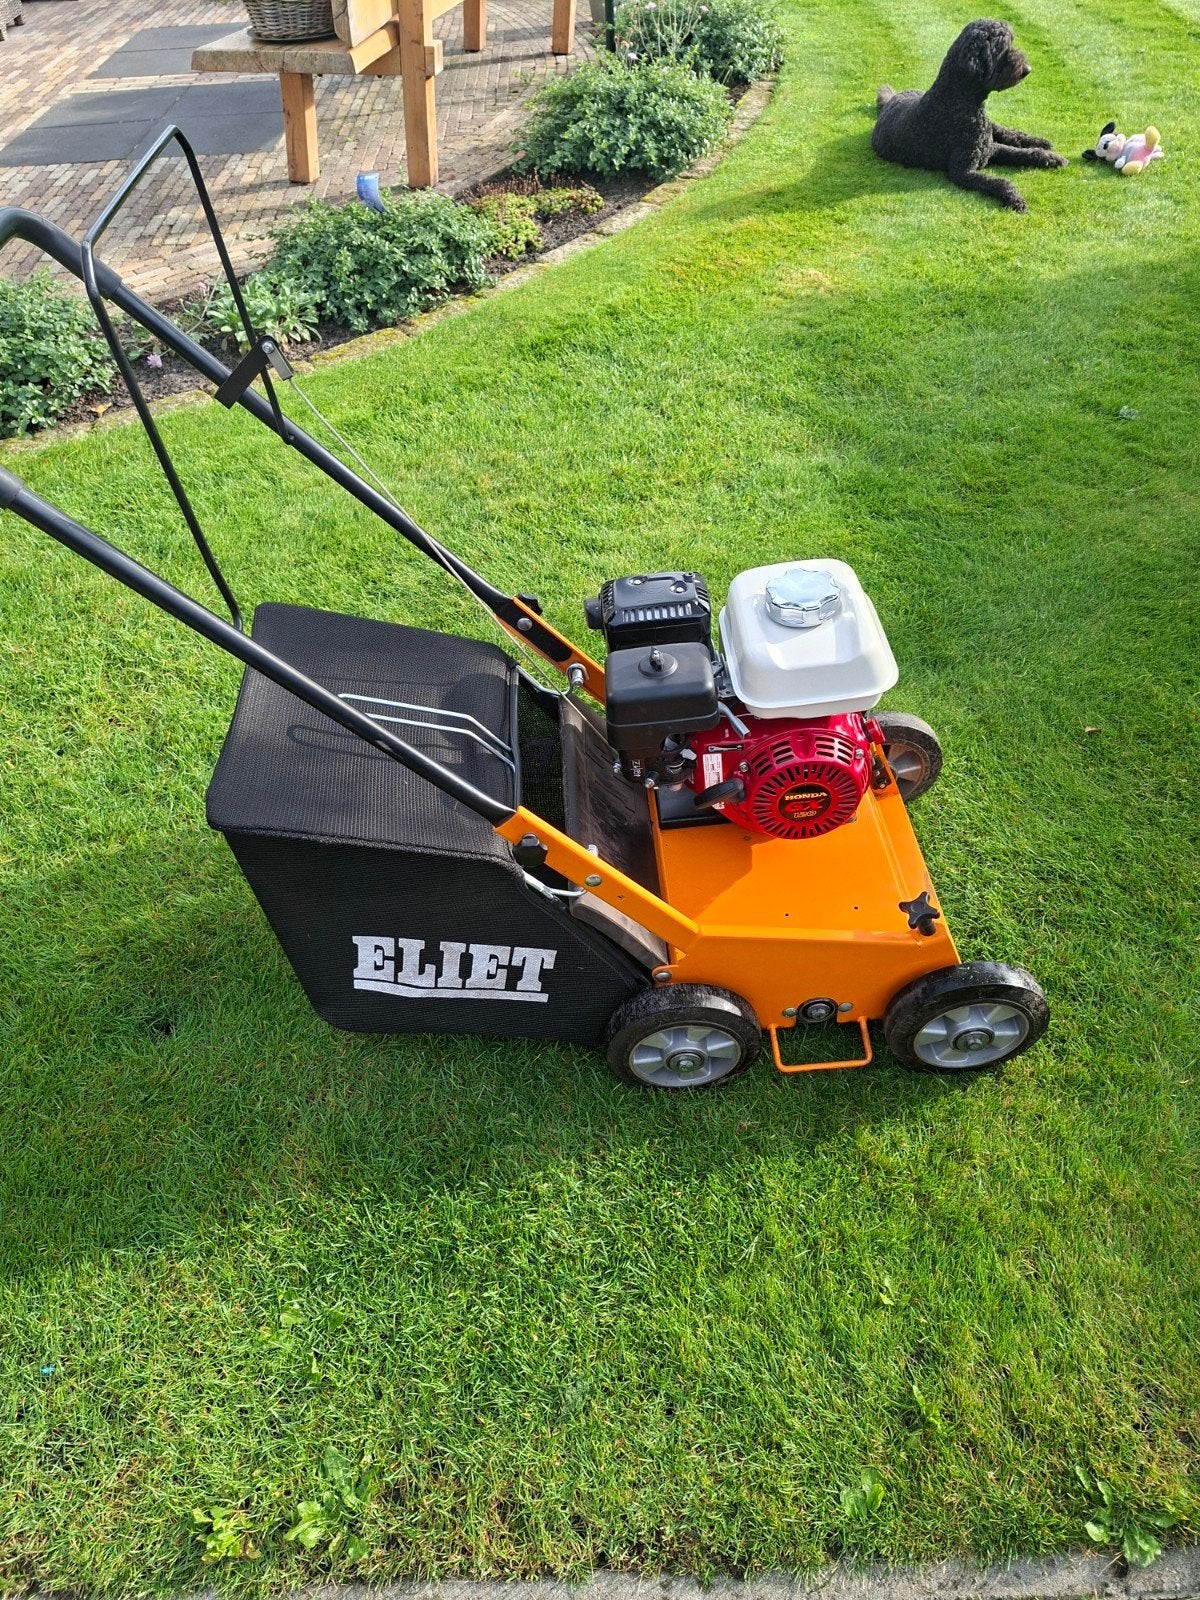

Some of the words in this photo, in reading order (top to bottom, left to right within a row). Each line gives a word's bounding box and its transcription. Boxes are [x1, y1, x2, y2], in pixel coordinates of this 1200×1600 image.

[784, 792, 828, 801] HONDA
[784, 799, 826, 812] GX
[352, 935, 558, 992] ELIET
